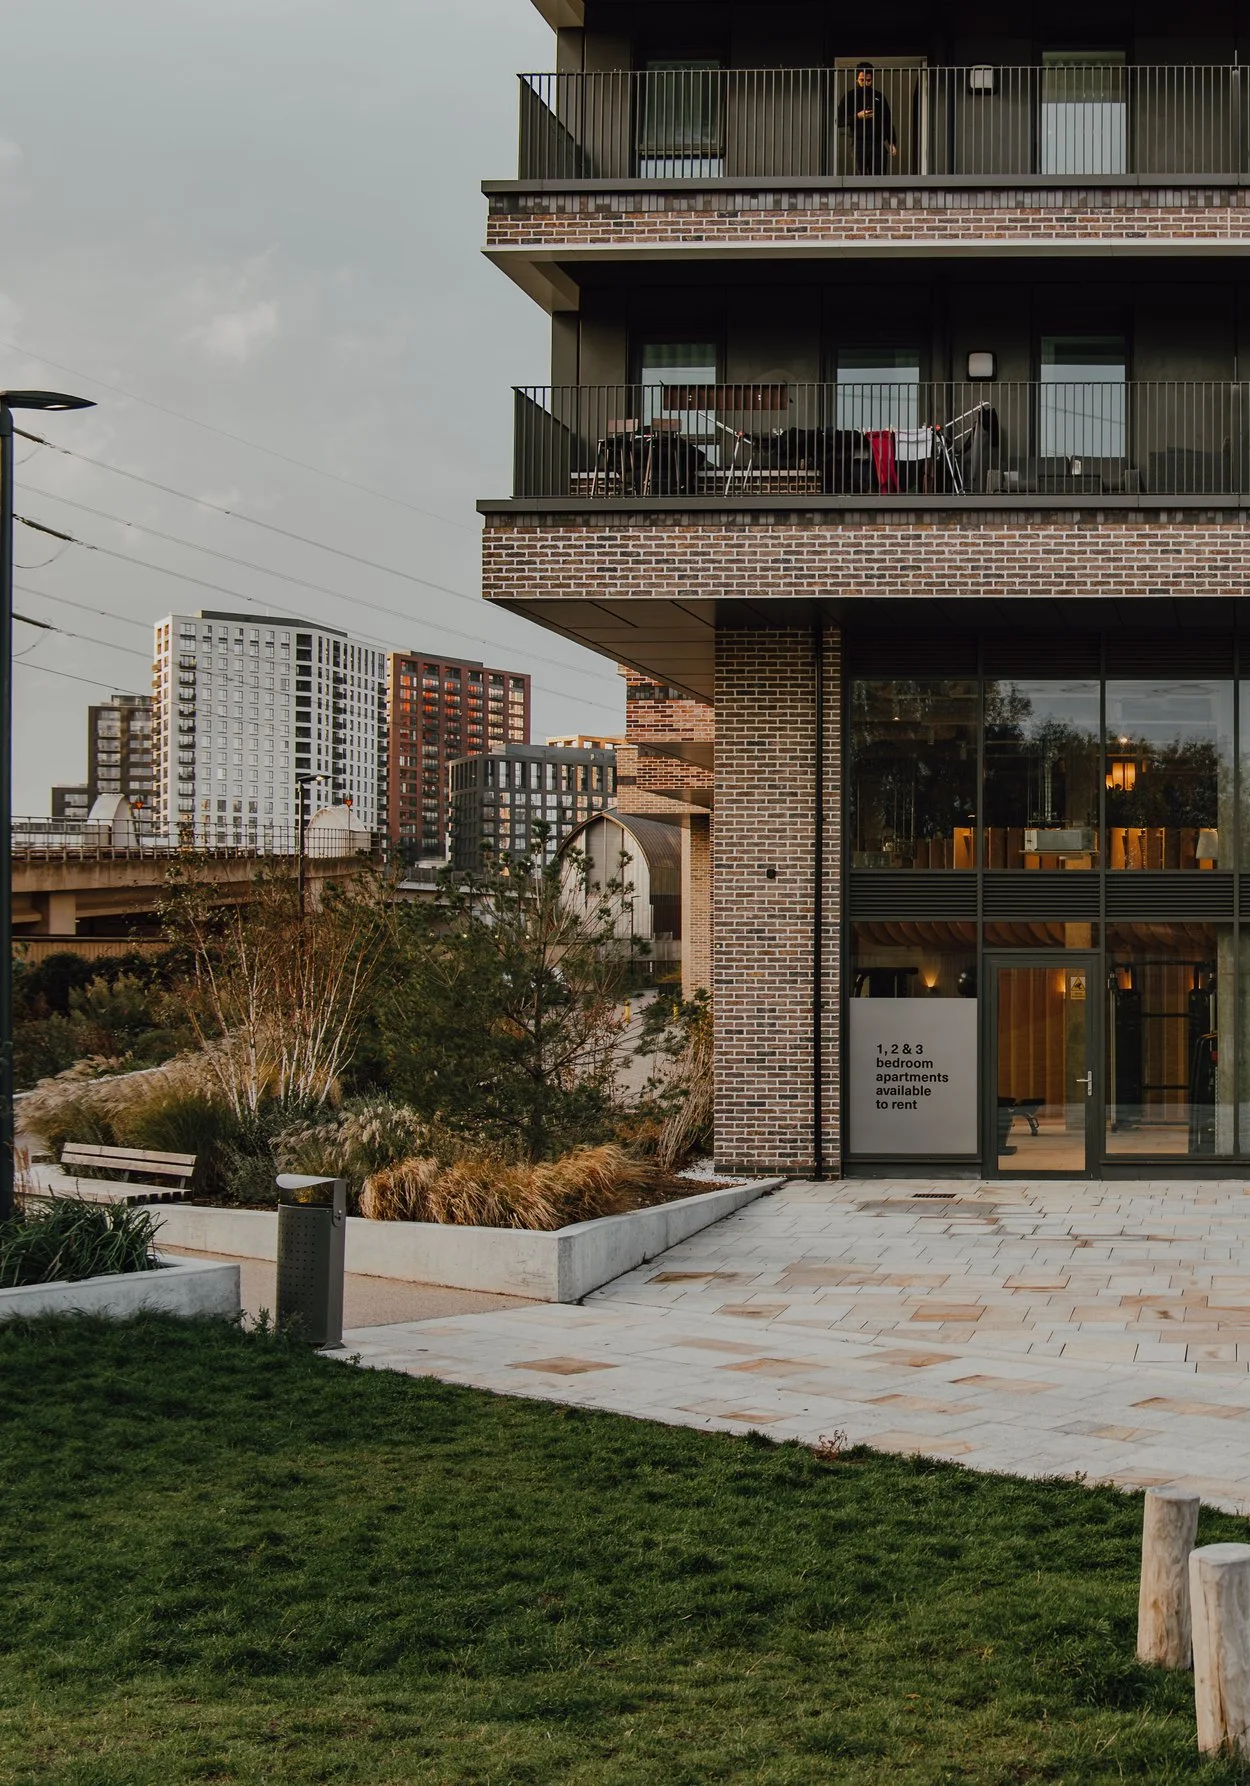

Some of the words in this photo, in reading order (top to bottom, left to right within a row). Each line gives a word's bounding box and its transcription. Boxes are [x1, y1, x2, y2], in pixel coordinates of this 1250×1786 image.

[877, 1044, 888, 1056] 1,
[891, 1044, 899, 1054] 2
[902, 1044, 912, 1054] &
[915, 1044, 924, 1054] 3
[876, 1057, 933, 1068] bedroom
[876, 1072, 949, 1084] apartments
[876, 1085, 932, 1096] available
[876, 1100, 888, 1109] to
[892, 1100, 917, 1109] rent
